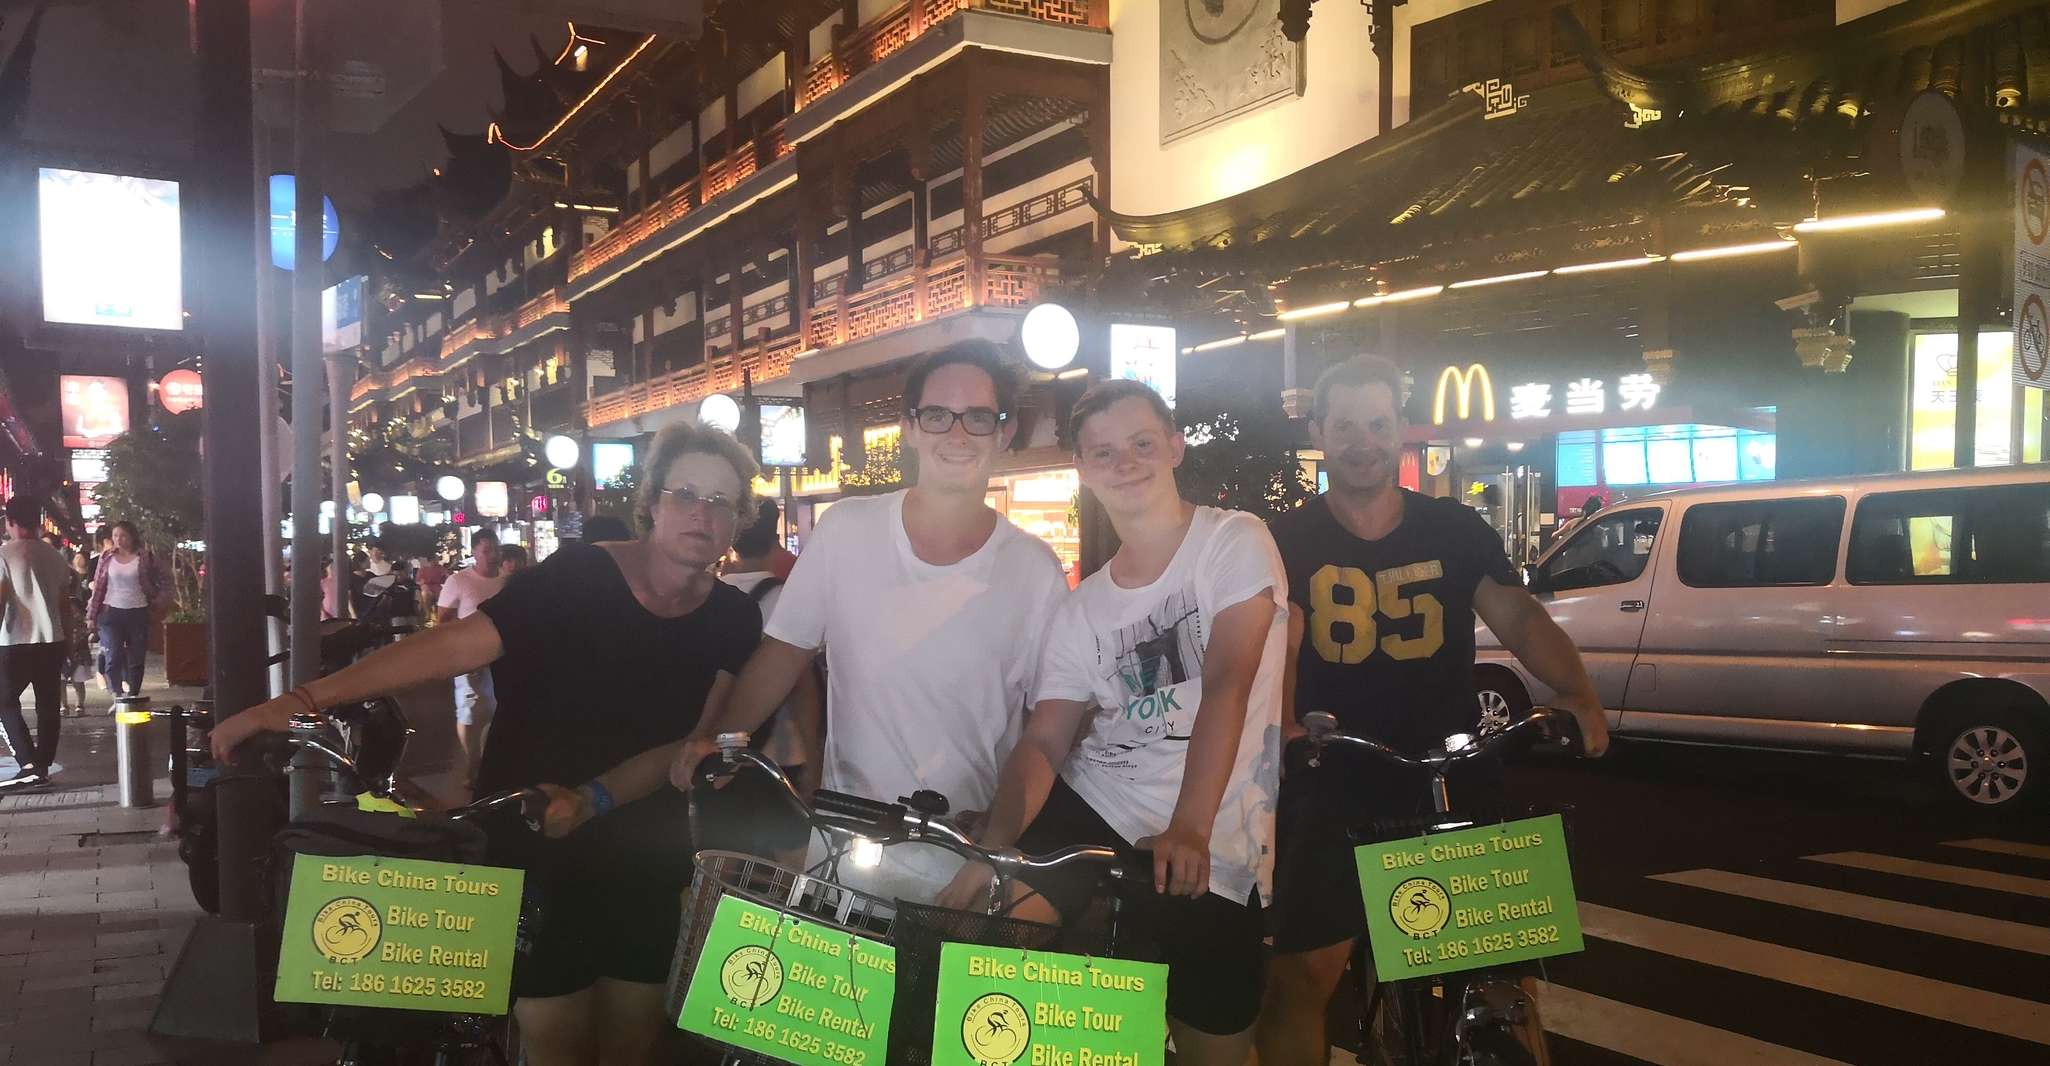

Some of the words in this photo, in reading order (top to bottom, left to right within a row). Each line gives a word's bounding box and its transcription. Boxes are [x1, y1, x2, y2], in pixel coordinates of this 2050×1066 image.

[1509, 373, 1662, 420] 麦当劳
[1309, 560, 1444, 665] 85
[1127, 688, 1183, 720] YOK
[1144, 720, 1174, 735] CIY
[1381, 852, 1425, 871] Bike
[1431, 843, 1486, 863] China
[1489, 832, 1543, 852] Tours
[322, 863, 371, 885] Bike
[377, 868, 437, 891] China
[444, 874, 499, 897] Tours
[1449, 875, 1489, 896] Bike
[1491, 868, 1529, 889] Tour
[386, 904, 429, 929] Bike
[435, 908, 475, 933] Tour
[1455, 908, 1494, 929] Bike
[1498, 896, 1553, 921] Rental
[738, 911, 783, 938] Bike
[788, 927, 841, 958] China
[1403, 947, 1433, 967] Tel:
[1437, 940, 1469, 961] 186
[1473, 934, 1515, 956] 1625
[1518, 926, 1560, 948] 3582
[1413, 930, 1438, 940] BCT
[329, 956, 359, 966] BCT
[381, 942, 423, 965] Bike
[429, 945, 488, 969] Rental
[312, 970, 342, 992] Tel:
[350, 972, 385, 993] 186
[389, 976, 436, 996] 1625
[440, 978, 485, 999] 3582
[788, 961, 828, 990] Bike
[831, 974, 869, 1002] Tour
[967, 956, 1016, 980] Bike
[1023, 961, 1083, 987] China
[1089, 967, 1145, 993] Tours
[776, 995, 816, 1022] Bike
[818, 1007, 876, 1040] Rental
[1034, 1002, 1077, 1028] Bike
[1082, 1006, 1123, 1032] Tour
[712, 1007, 739, 1031] Tel:
[743, 1018, 777, 1040] 186
[777, 1028, 822, 1054] 1625
[823, 1041, 867, 1066] 3582
[1031, 1043, 1073, 1066] Bike
[1079, 1048, 1139, 1066] Rental
